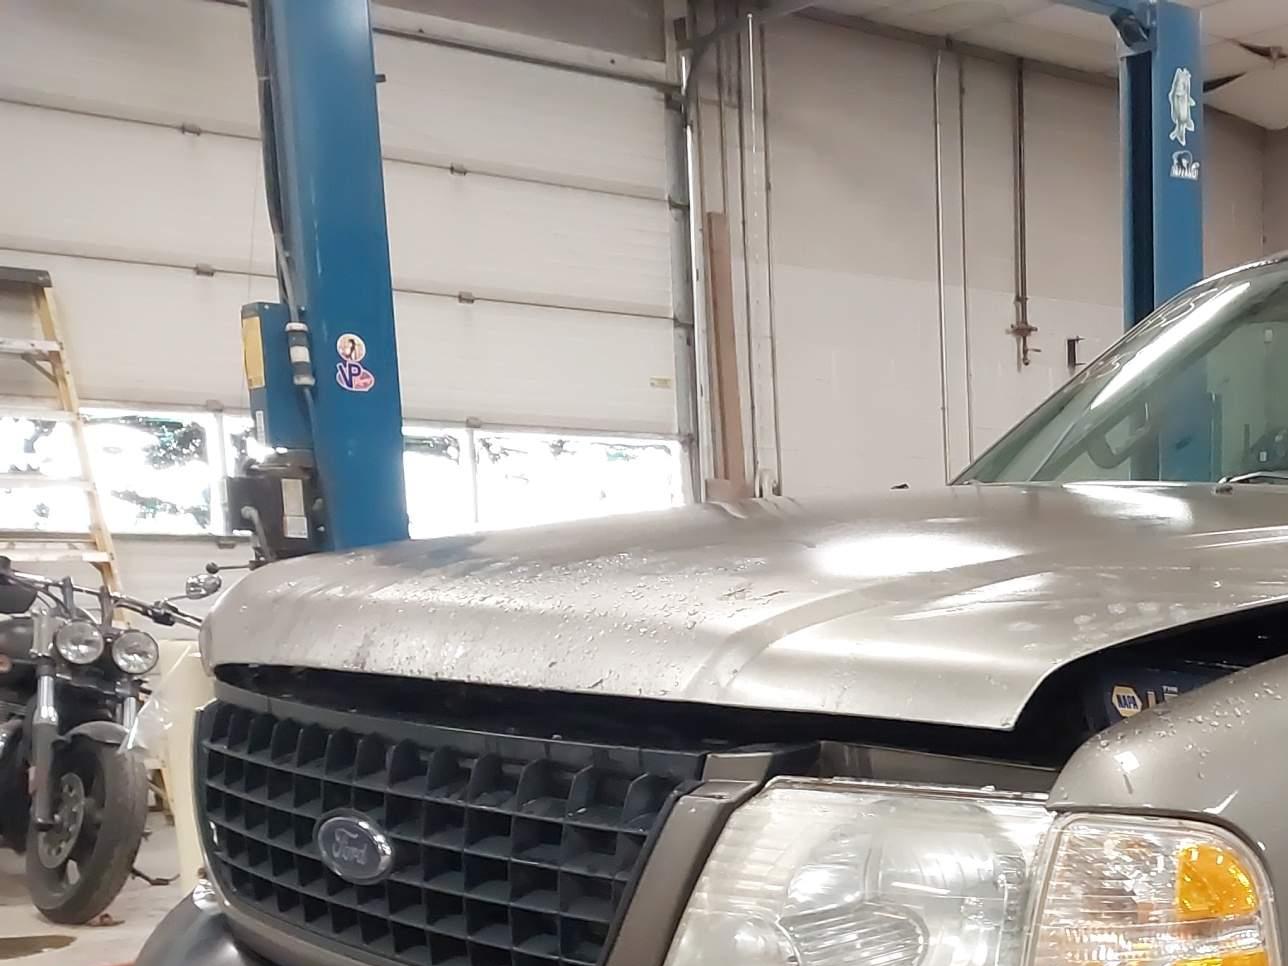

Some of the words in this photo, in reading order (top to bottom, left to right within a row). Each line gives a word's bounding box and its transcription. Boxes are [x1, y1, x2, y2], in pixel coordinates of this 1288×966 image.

[339, 362, 361, 388] VP
[1116, 694, 1139, 710] NAPA
[332, 828, 368, 865] Ford
